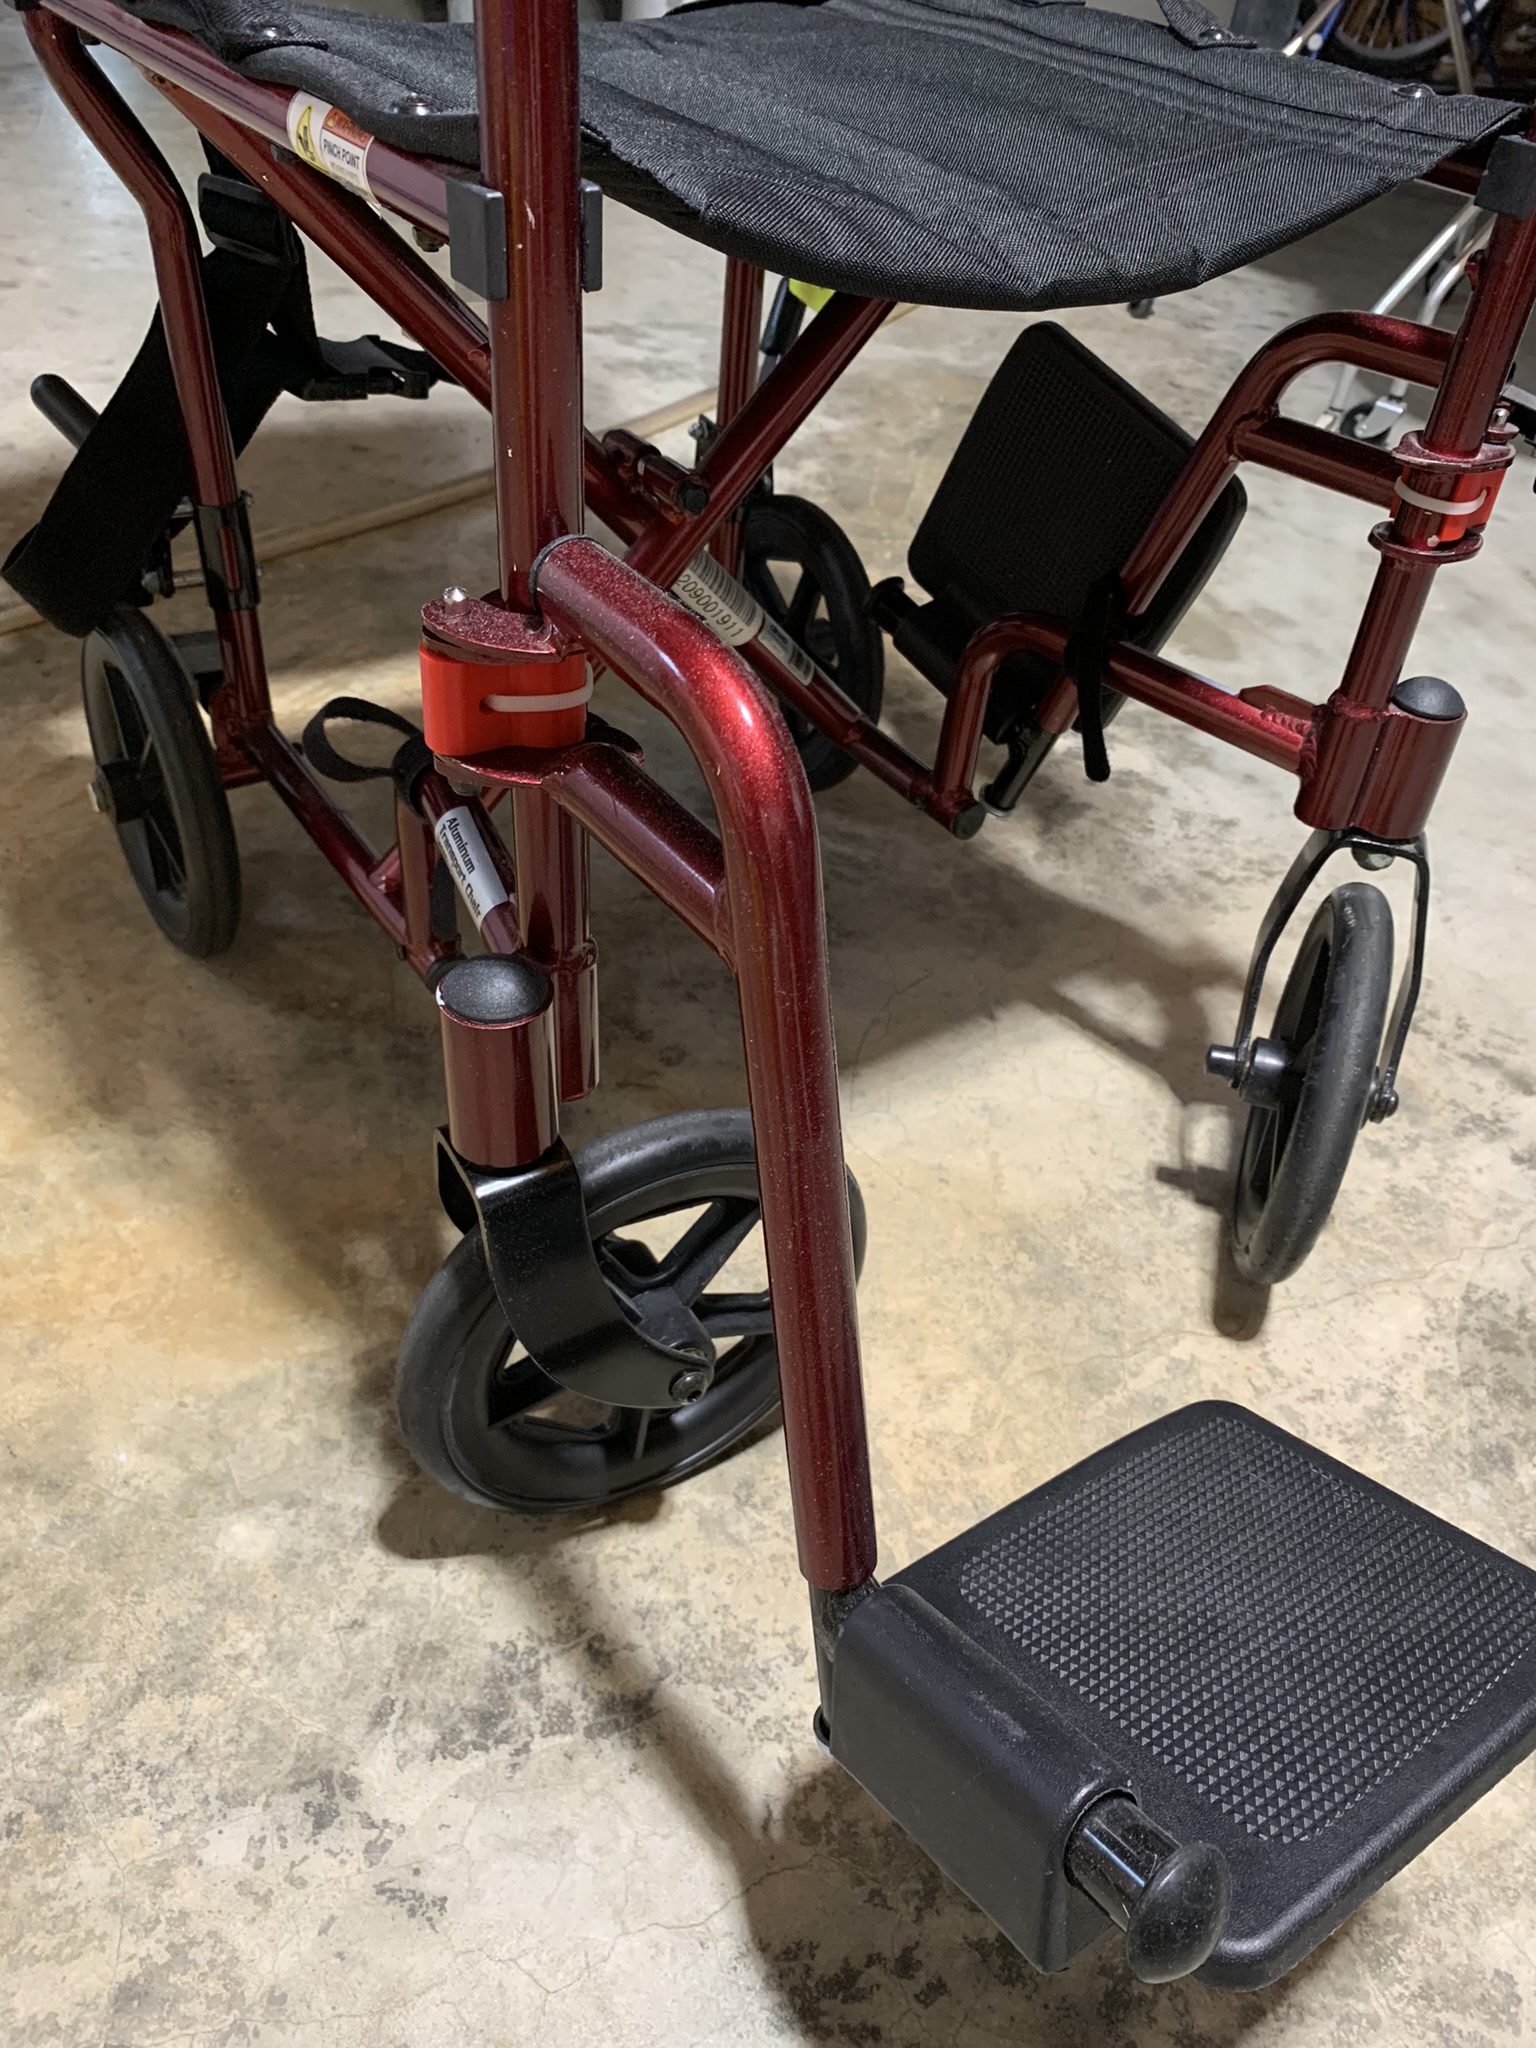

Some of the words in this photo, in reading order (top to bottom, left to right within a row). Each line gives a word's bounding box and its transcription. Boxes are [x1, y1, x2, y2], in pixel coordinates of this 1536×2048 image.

[323, 138, 341, 159] PINCH
[341, 148, 361, 169] POINT
[439, 823, 466, 885] Transport
[465, 882, 482, 918] Chair
[446, 817, 475, 875] Aluminum
